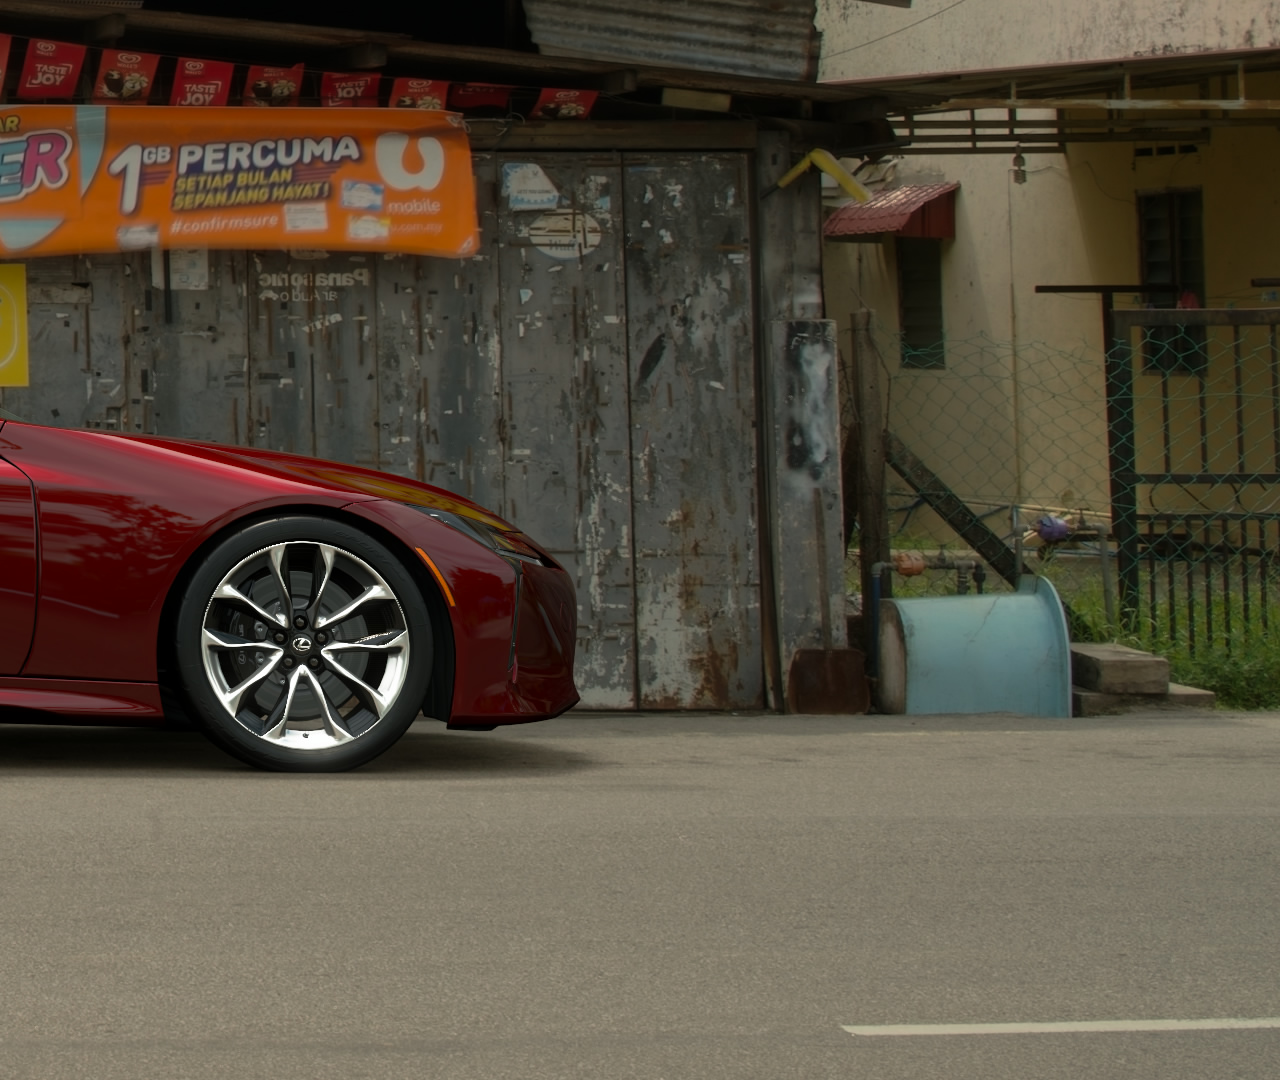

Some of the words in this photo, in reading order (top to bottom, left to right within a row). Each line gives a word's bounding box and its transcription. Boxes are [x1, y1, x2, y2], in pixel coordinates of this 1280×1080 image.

[35, 63, 67, 74] TASTE
[32, 73, 65, 86] JOY
[334, 80, 364, 89] TASTE
[184, 84, 216, 94] TASTE
[337, 87, 366, 98] JOY
[182, 93, 215, 106] JOY
[178, 136, 360, 174] PERCUMA
[176, 173, 233, 192] SETIAP
[236, 168, 292, 186] BULAN
[173, 188, 270, 209] SEPANJANG
[389, 198, 440, 213] mobile
[171, 214, 278, 235] #confirmsure
